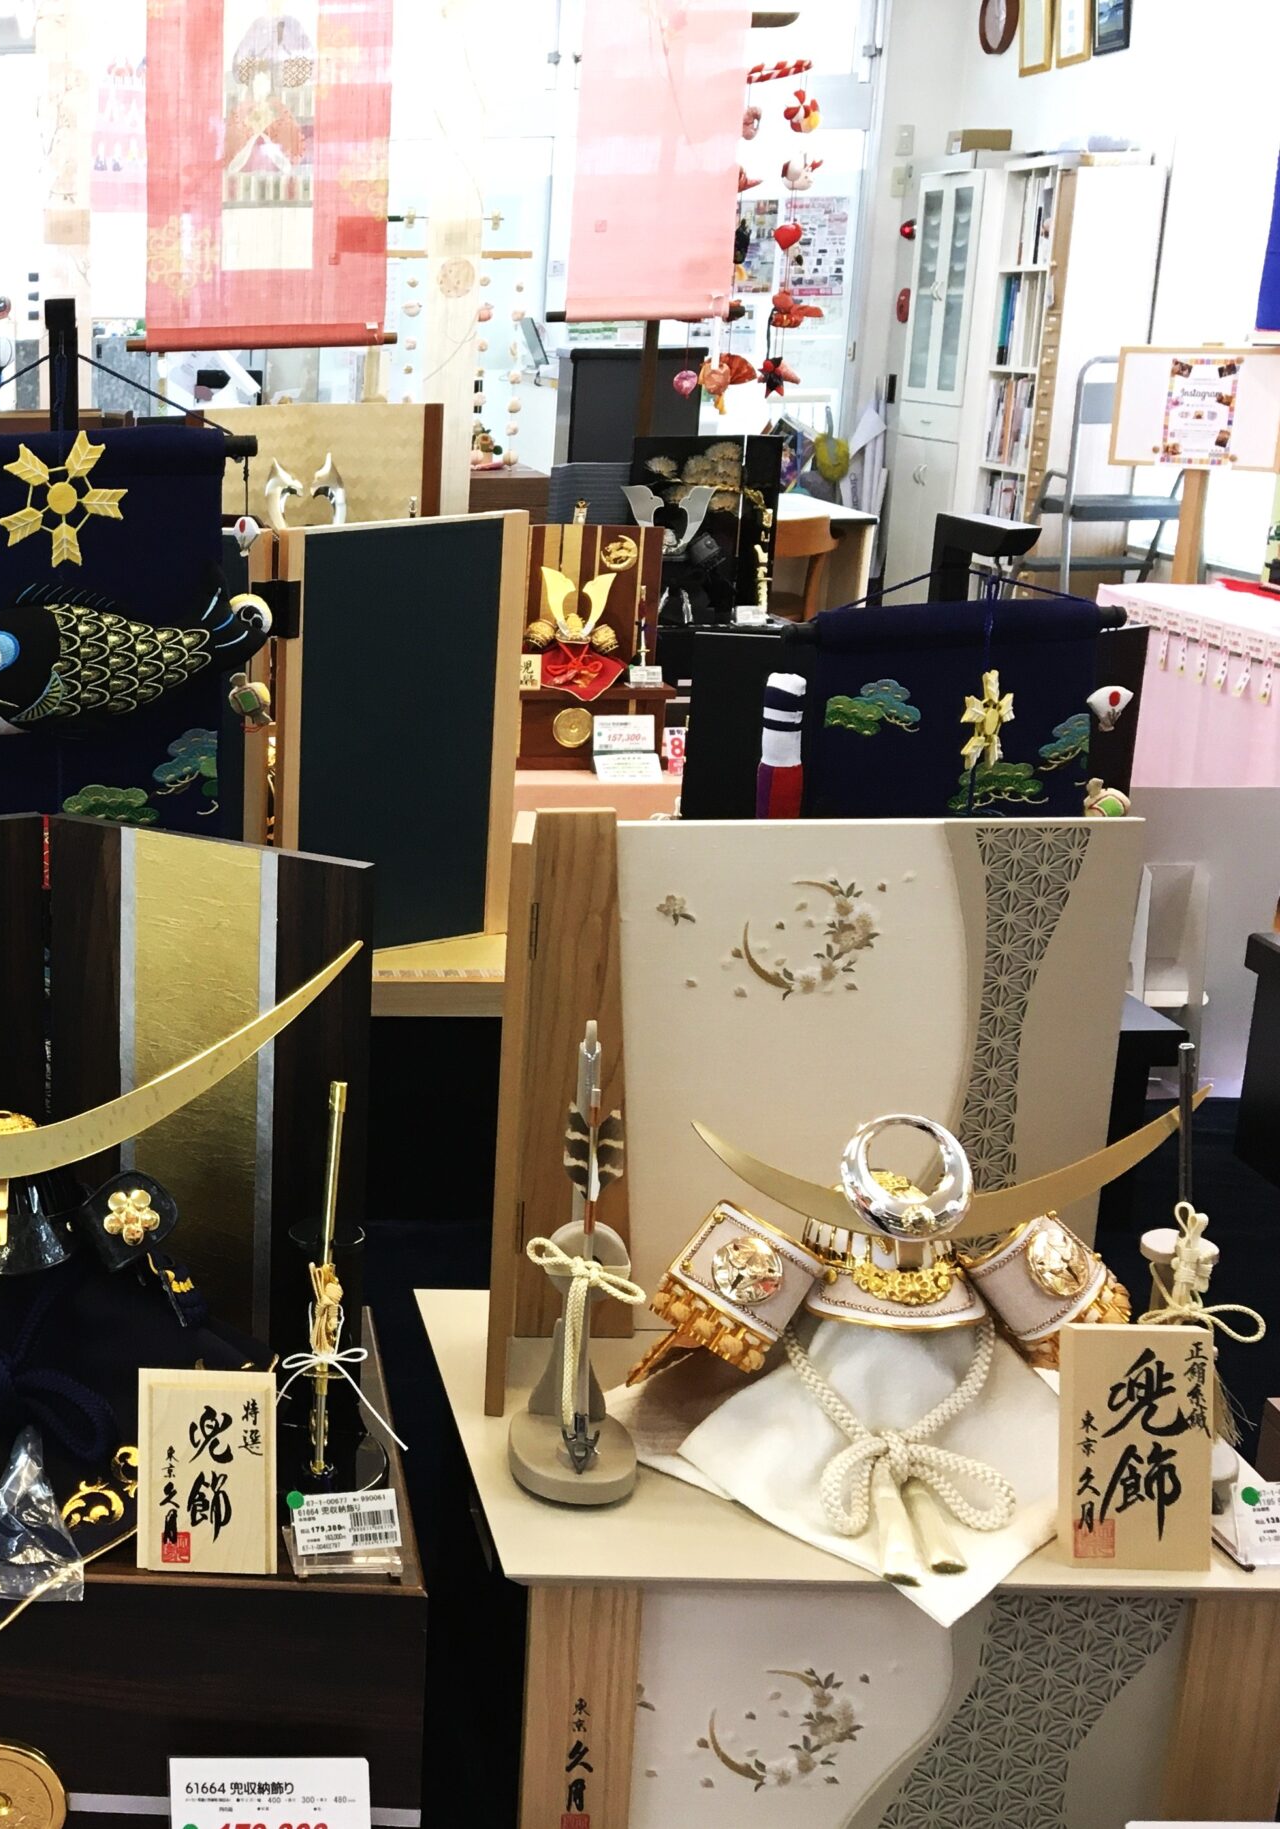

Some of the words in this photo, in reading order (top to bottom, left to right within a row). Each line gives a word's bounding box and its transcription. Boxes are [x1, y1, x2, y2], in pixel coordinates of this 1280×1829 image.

[1180, 388, 1222, 400] Instagram
[238, 1398, 263, 1456] 特選
[1099, 1347, 1191, 1542] 兜飾
[186, 1404, 234, 1543] 兜飾
[185, 1782, 227, 1796] 61664
[230, 1782, 295, 1796] 兜収納飾り
